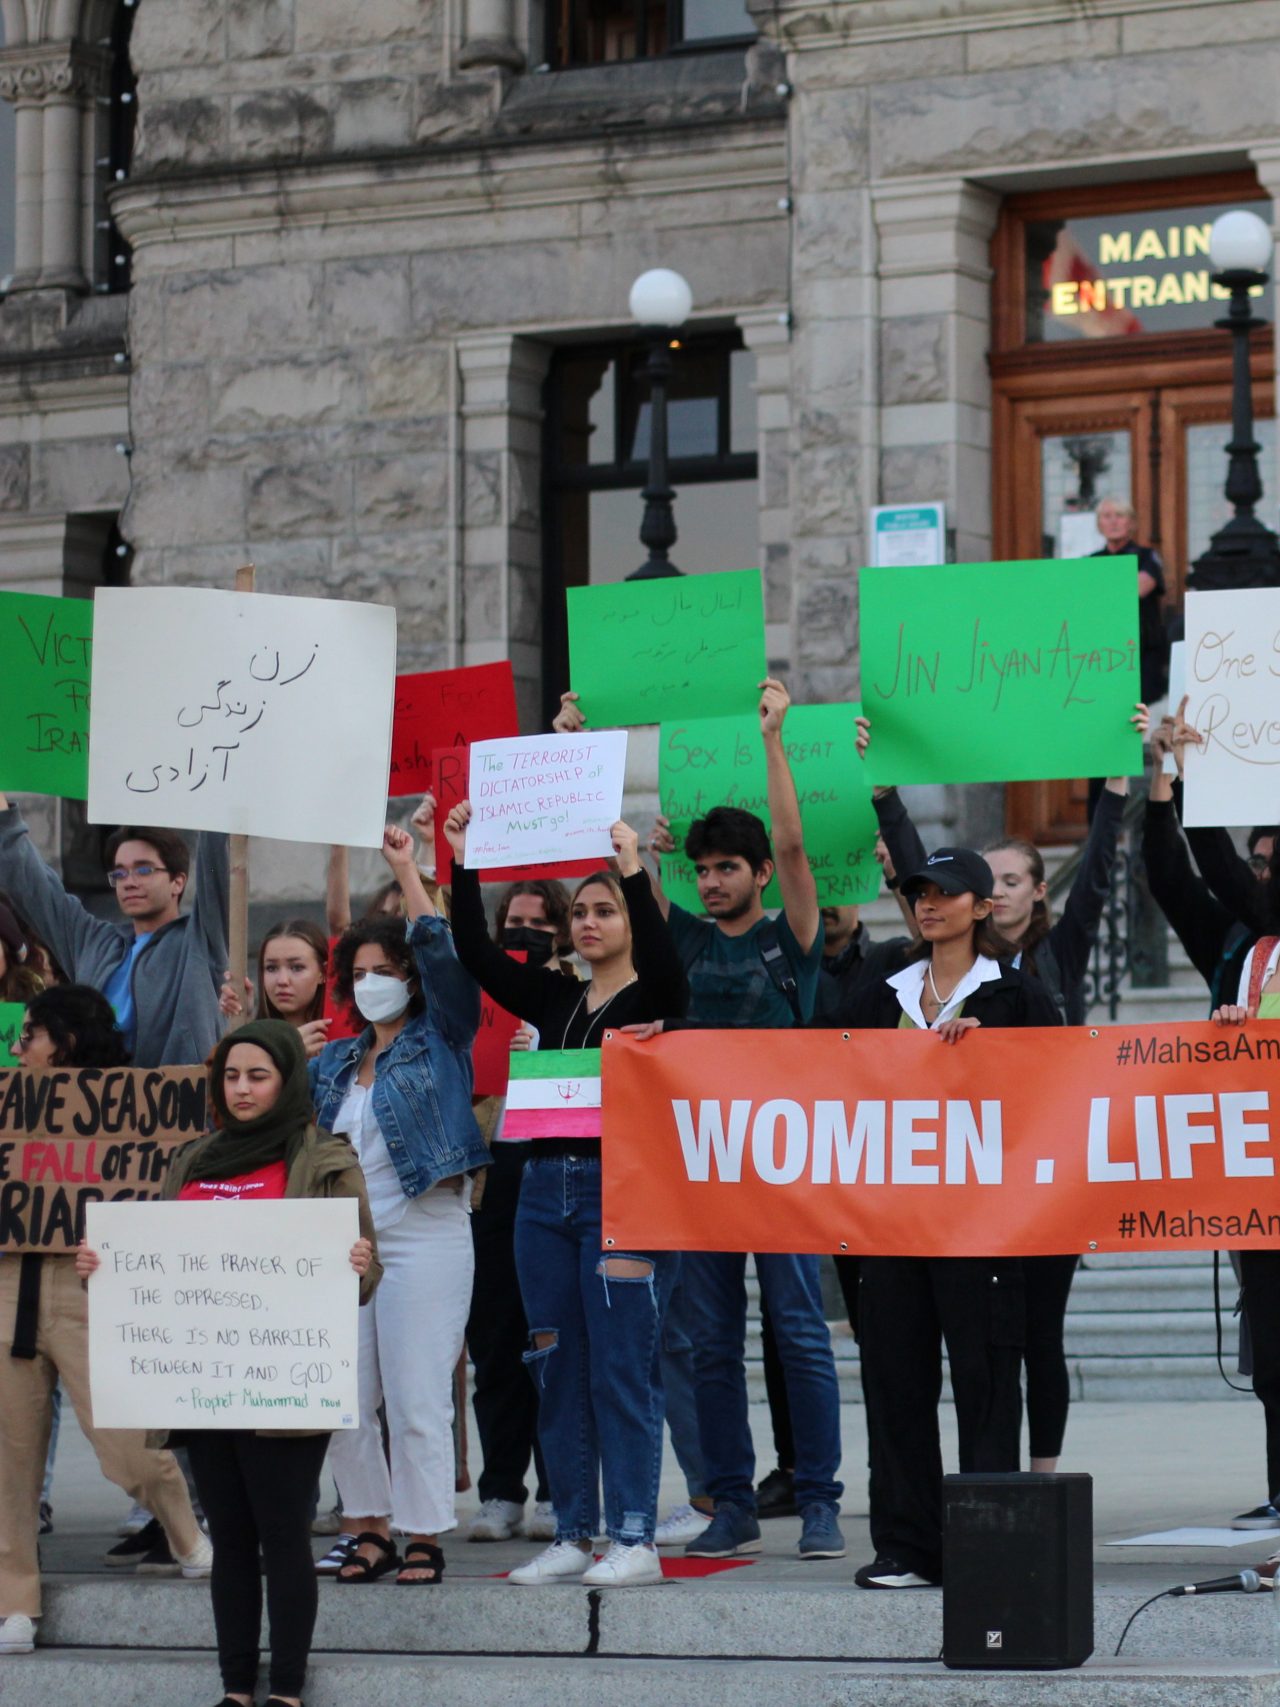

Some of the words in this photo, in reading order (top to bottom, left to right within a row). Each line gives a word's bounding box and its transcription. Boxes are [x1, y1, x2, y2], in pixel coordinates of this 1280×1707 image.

[1052, 270, 1264, 316] ENTRAN
[17, 612, 92, 668] VICT
[874, 622, 940, 700] JIN
[1194, 630, 1256, 683] One
[249, 643, 319, 686] زن
[126, 741, 240, 794] آزادی
[507, 745, 599, 771] TERRORIST
[664, 728, 718, 773] Sex
[785, 738, 835, 763] REAT
[480, 767, 584, 797] DICTATORSHIP
[479, 801, 533, 822] ISLAMIC
[537, 791, 606, 812] REPUBLIC
[73, 1068, 206, 1137] SEASON
[671, 1097, 1003, 1186] WOMEN
[1087, 1090, 1275, 1184] LIFE
[22, 1140, 102, 1183] FALL
[102, 1141, 135, 1181] OF
[136, 1140, 177, 1182] TH
[178, 1253, 210, 1273] THE
[221, 1252, 286, 1275] PRAYER
[296, 1257, 323, 1278] OF
[130, 1286, 162, 1306] THE
[116, 1323, 173, 1345] THERE
[186, 1329, 209, 1346] IS
[217, 1329, 240, 1347] NO
[249, 1328, 331, 1349] BARRIER
[130, 1355, 203, 1376] BETWEEN
[211, 1360, 235, 1379] IT
[244, 1365, 278, 1382] AND
